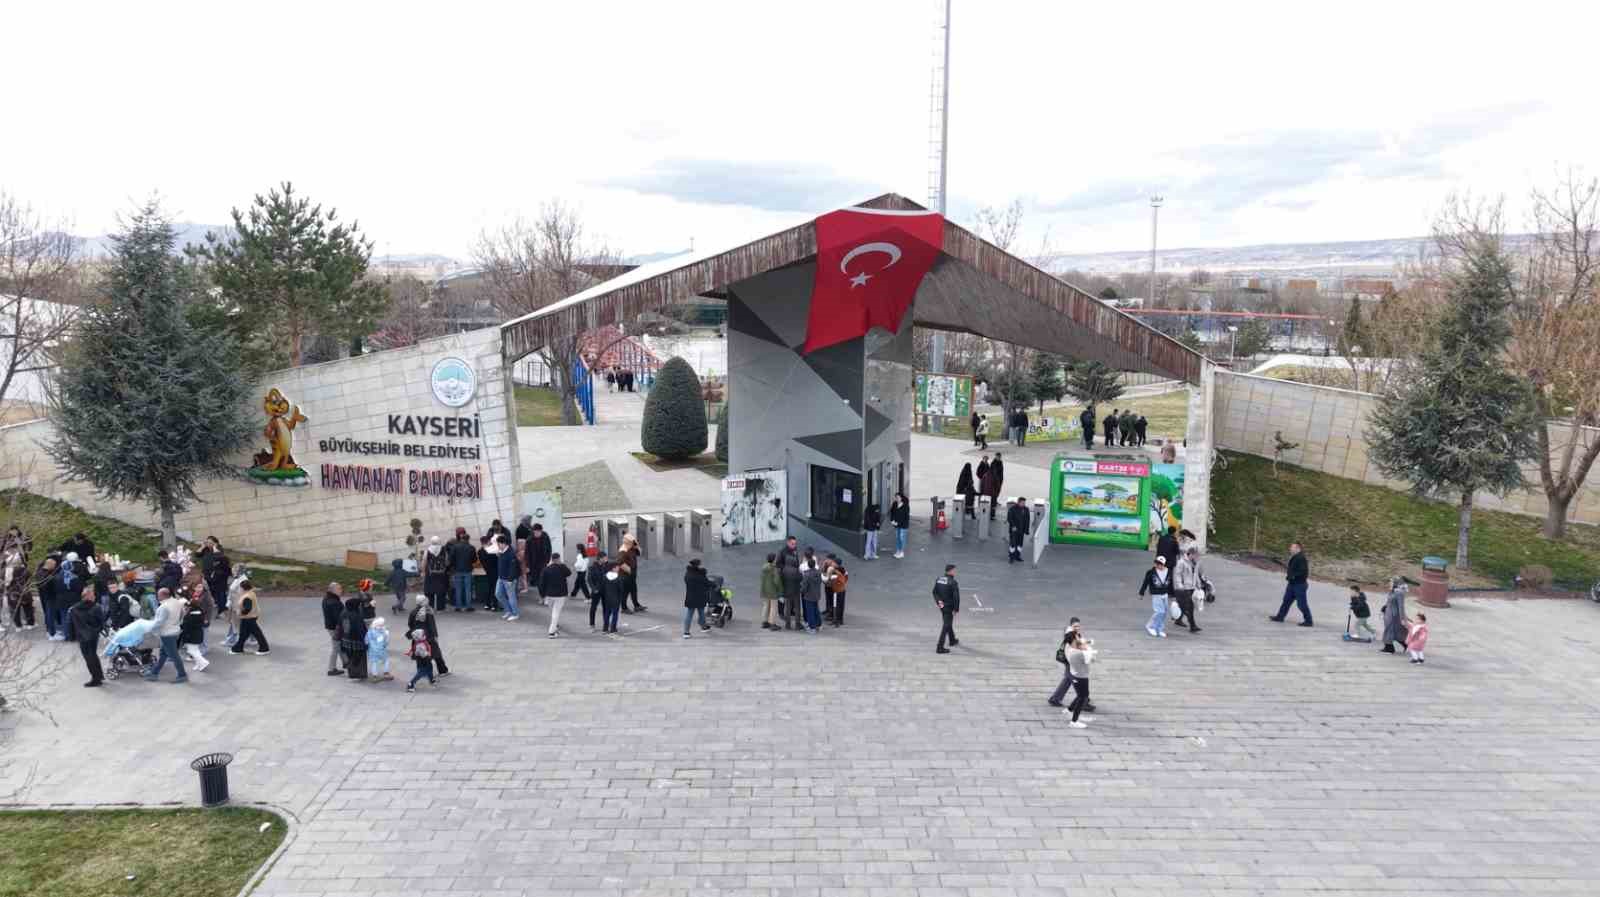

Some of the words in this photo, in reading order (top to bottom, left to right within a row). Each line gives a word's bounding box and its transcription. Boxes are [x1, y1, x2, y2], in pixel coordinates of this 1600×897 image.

[388, 413, 480, 438] KAYSERİ
[319, 437, 400, 456] BÜYÜKŞEHİR
[404, 444, 480, 460] BELEDİYESİ
[321, 464, 403, 494] HAYVANAT
[409, 466, 481, 502] BAHÇESİ
